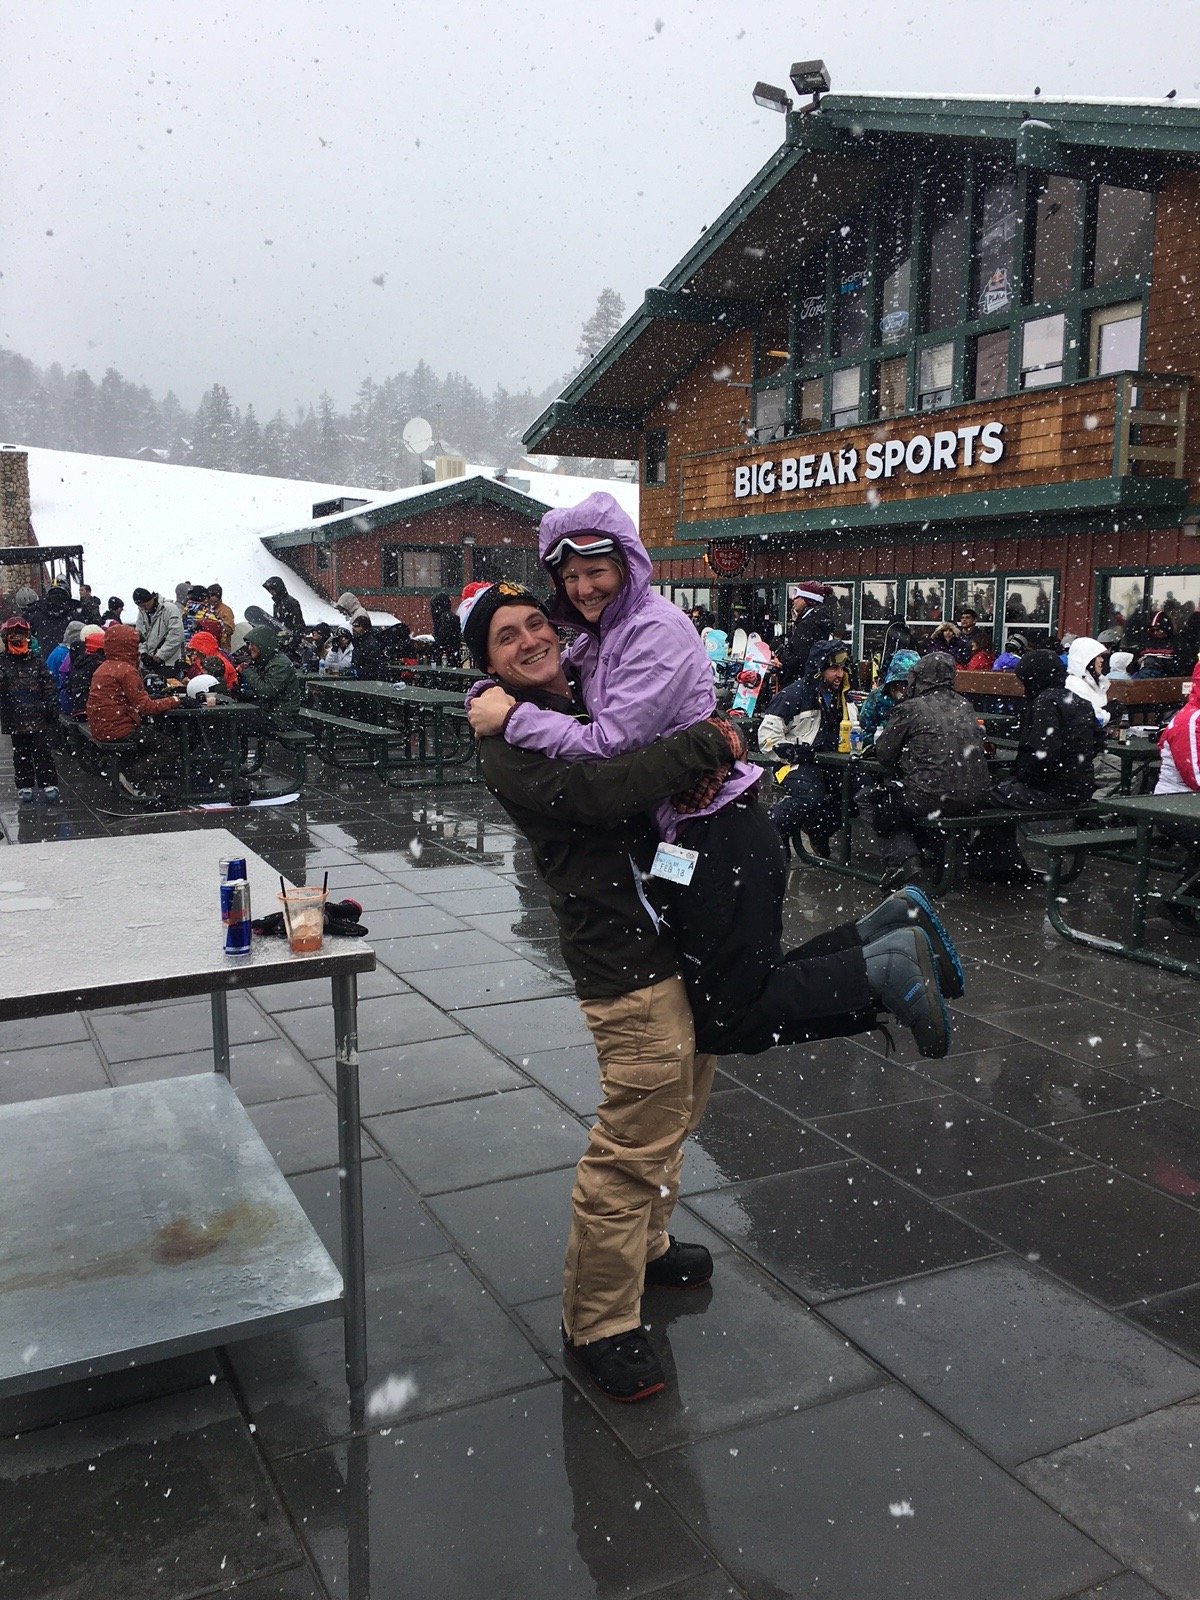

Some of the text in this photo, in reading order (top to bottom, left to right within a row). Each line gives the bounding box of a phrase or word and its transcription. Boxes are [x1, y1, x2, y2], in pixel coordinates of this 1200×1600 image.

[735, 421, 1005, 498] BIG BEAR SPORTS
[660, 862, 673, 874] FEB
